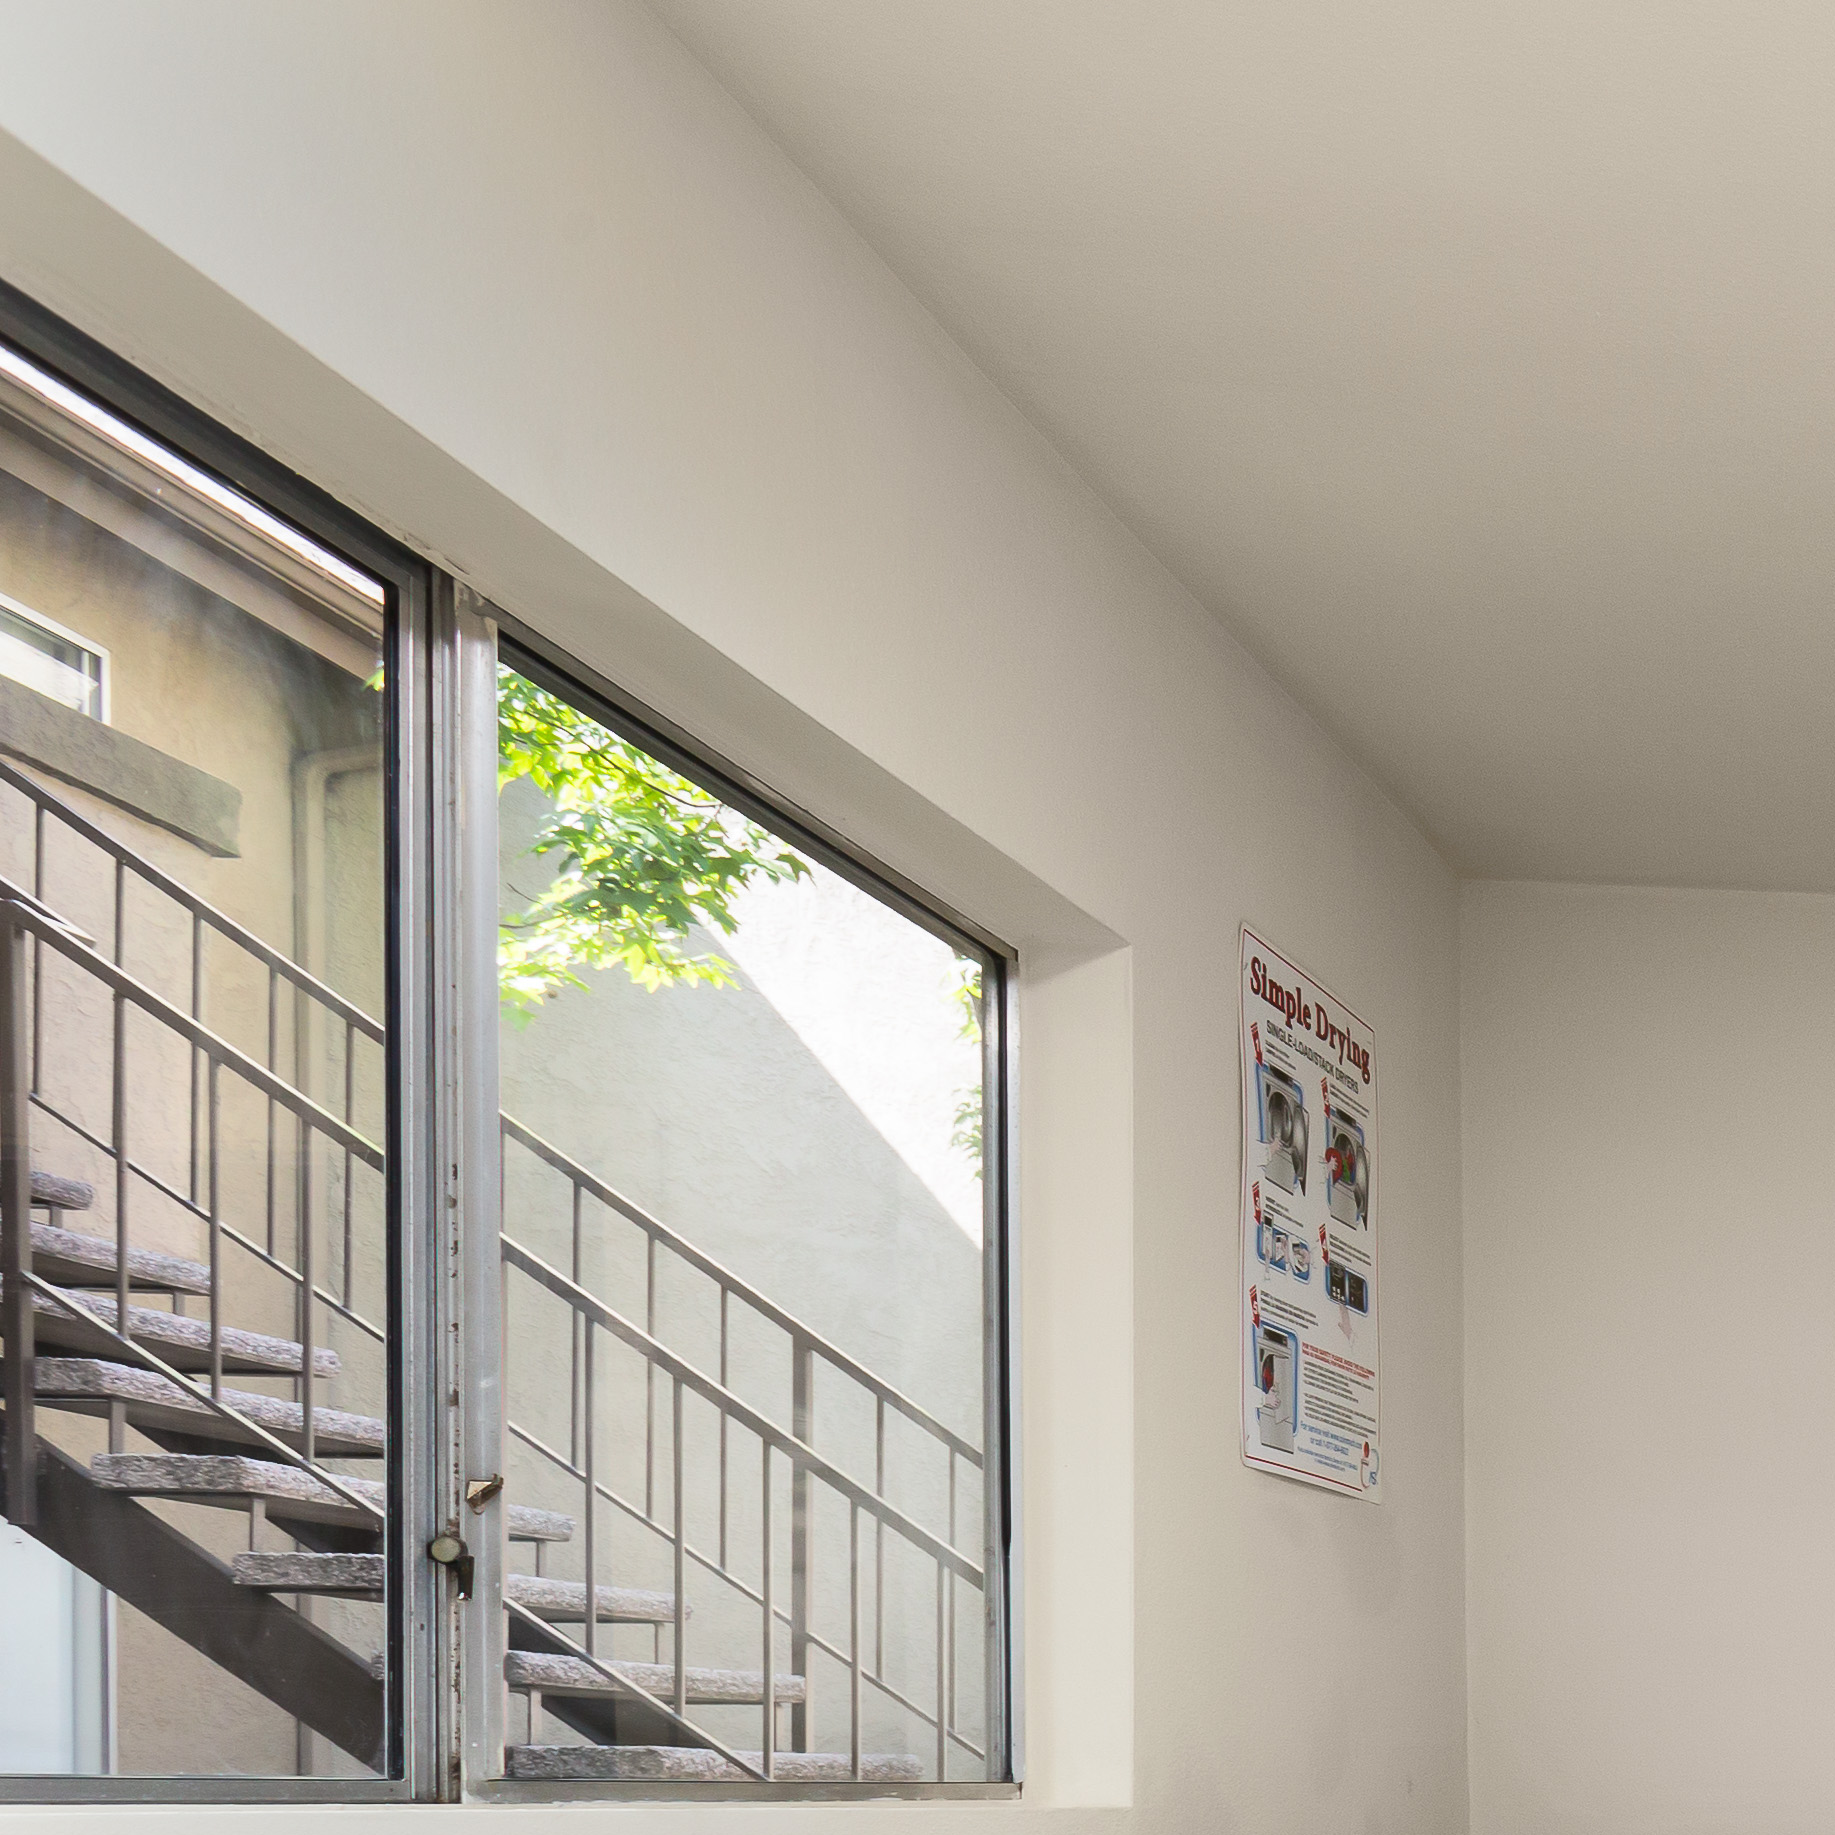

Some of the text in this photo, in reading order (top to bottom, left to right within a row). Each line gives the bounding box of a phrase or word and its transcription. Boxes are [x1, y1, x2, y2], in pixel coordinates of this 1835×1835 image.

[1249, 956, 1311, 1030] Simple
[1314, 1001, 1370, 1084] Drying
[1335, 1067, 1358, 1094] DRYERS
